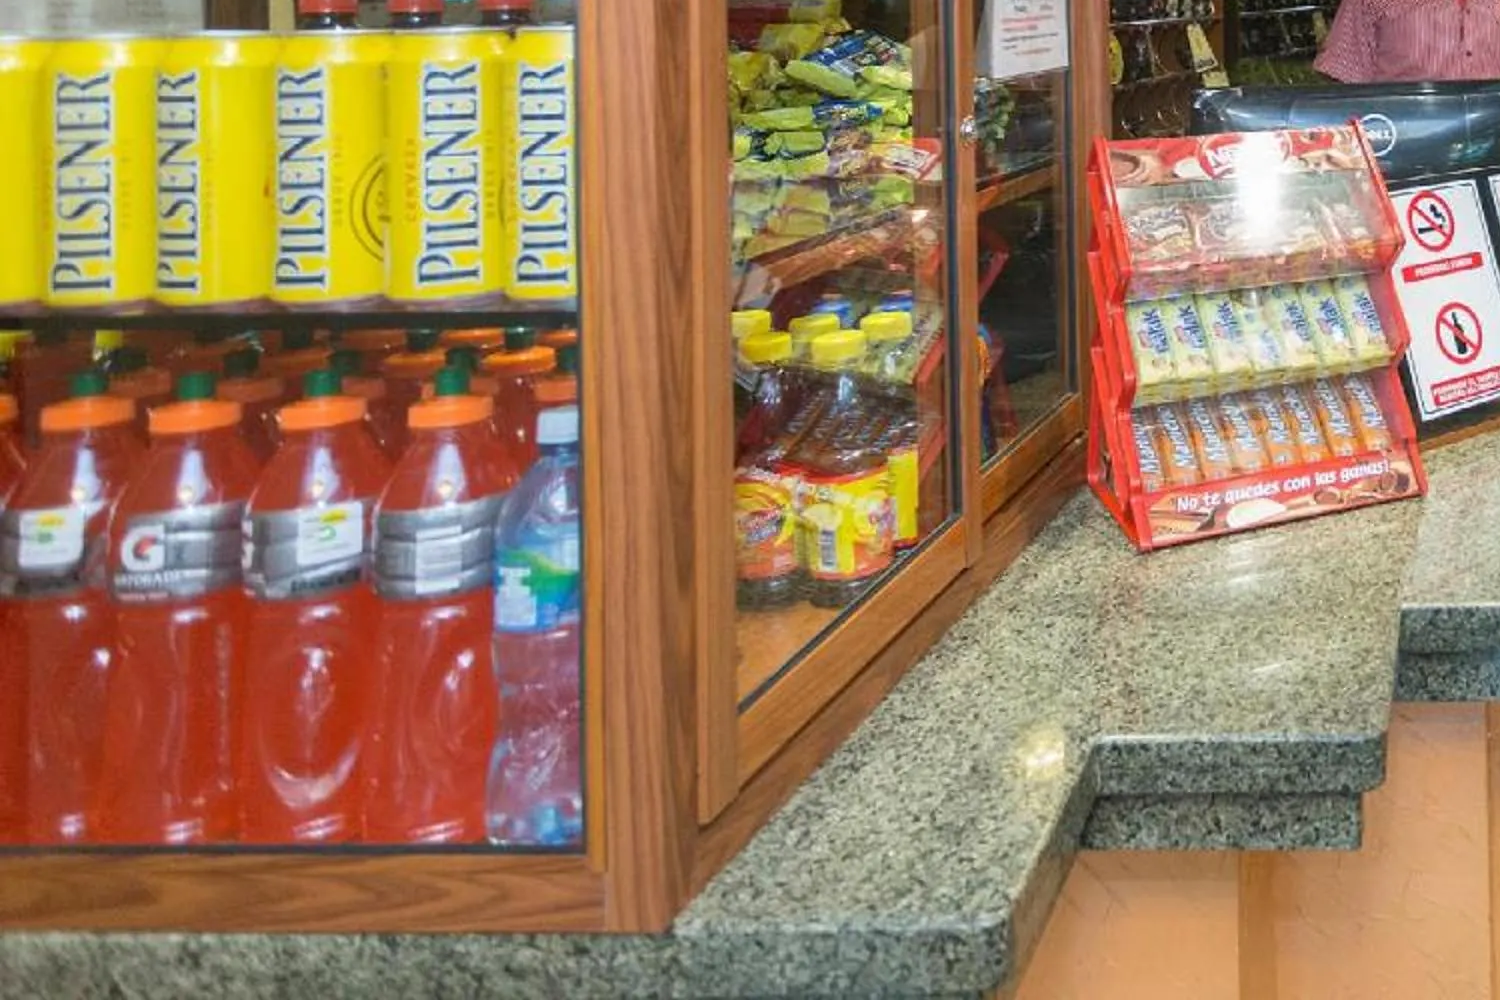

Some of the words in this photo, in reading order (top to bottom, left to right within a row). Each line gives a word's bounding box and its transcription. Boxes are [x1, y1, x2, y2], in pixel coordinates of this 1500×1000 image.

[51, 70, 113, 294] PILSENER
[156, 69, 199, 292] PILSENER
[275, 67, 327, 288] PILSENER
[416, 62, 480, 284] PILSENER
[515, 62, 570, 283] PILSENER
[1176, 494, 1199, 512] No
[1205, 489, 1223, 506] te
[1225, 480, 1281, 507] quedes
[1283, 475, 1312, 493] con
[1315, 469, 1337, 486] las
